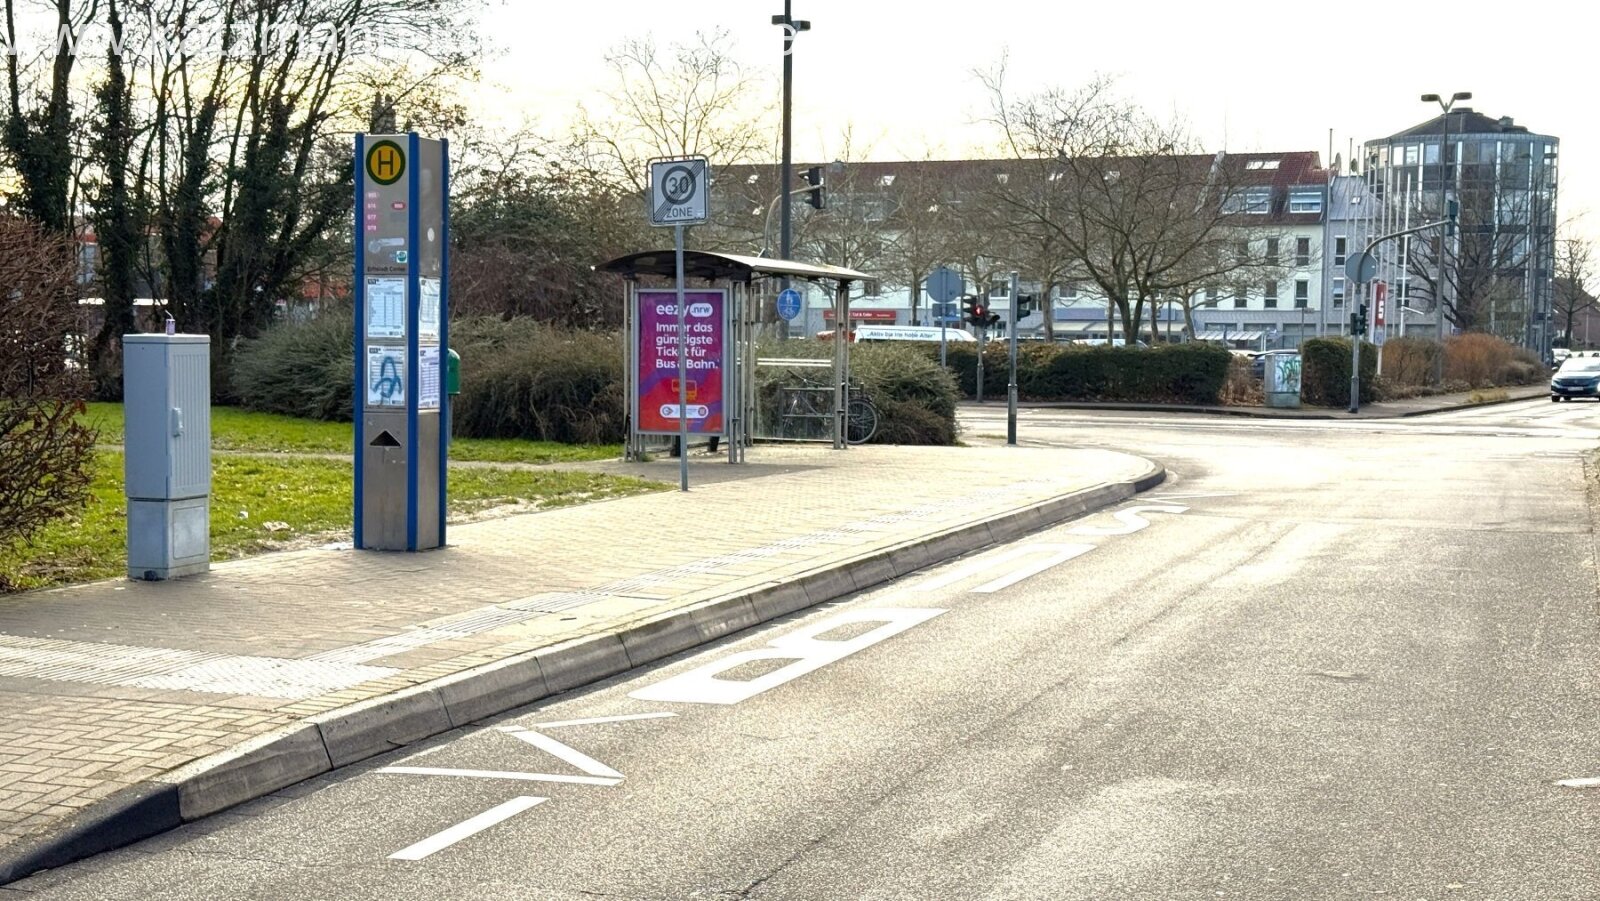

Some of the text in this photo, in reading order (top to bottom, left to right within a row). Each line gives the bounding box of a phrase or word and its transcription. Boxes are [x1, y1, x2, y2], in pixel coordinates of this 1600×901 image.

[377, 149, 394, 176] H
[669, 176, 689, 194] 30
[666, 207, 693, 218] ZONE
[656, 322, 713, 332] Immr das
[656, 334, 713, 346] günsigste
[656, 346, 707, 357] Tickt für
[656, 359, 676, 369] Bus
